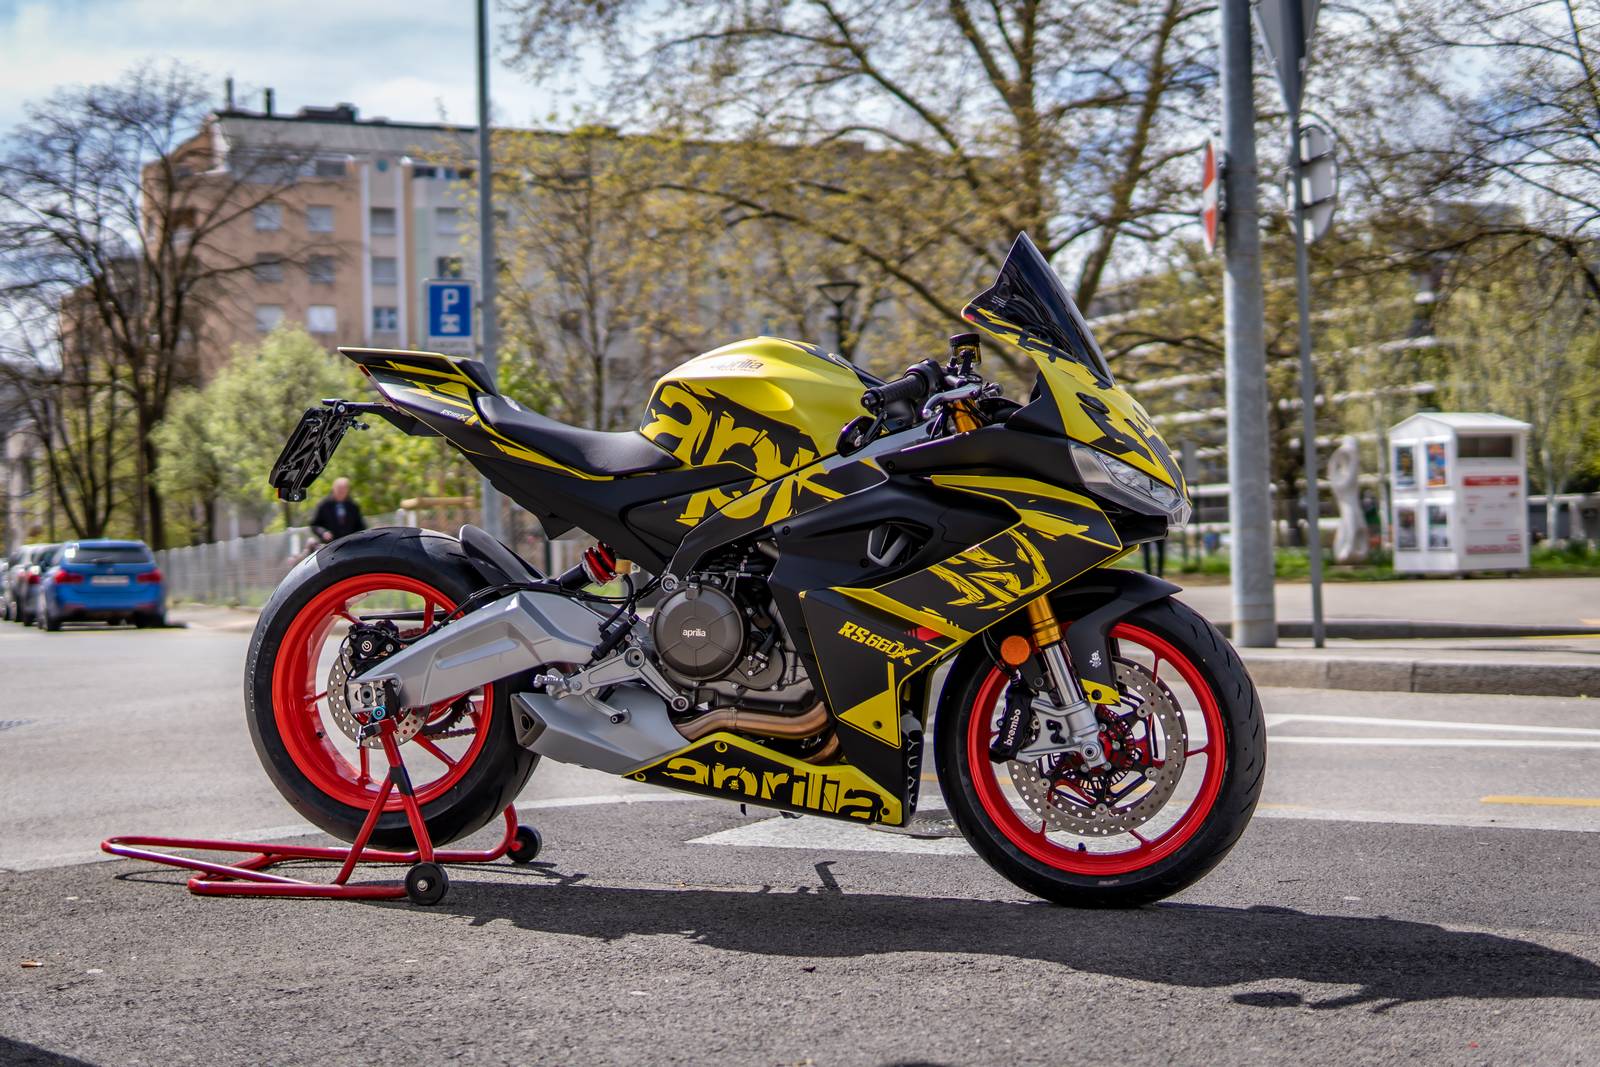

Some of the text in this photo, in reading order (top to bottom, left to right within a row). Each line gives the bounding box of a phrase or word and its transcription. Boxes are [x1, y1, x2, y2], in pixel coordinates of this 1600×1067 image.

[442, 289, 460, 313] P
[682, 628, 706, 638] aprilia
[837, 620, 922, 667] RS660X
[1003, 708, 1021, 747] brembo
